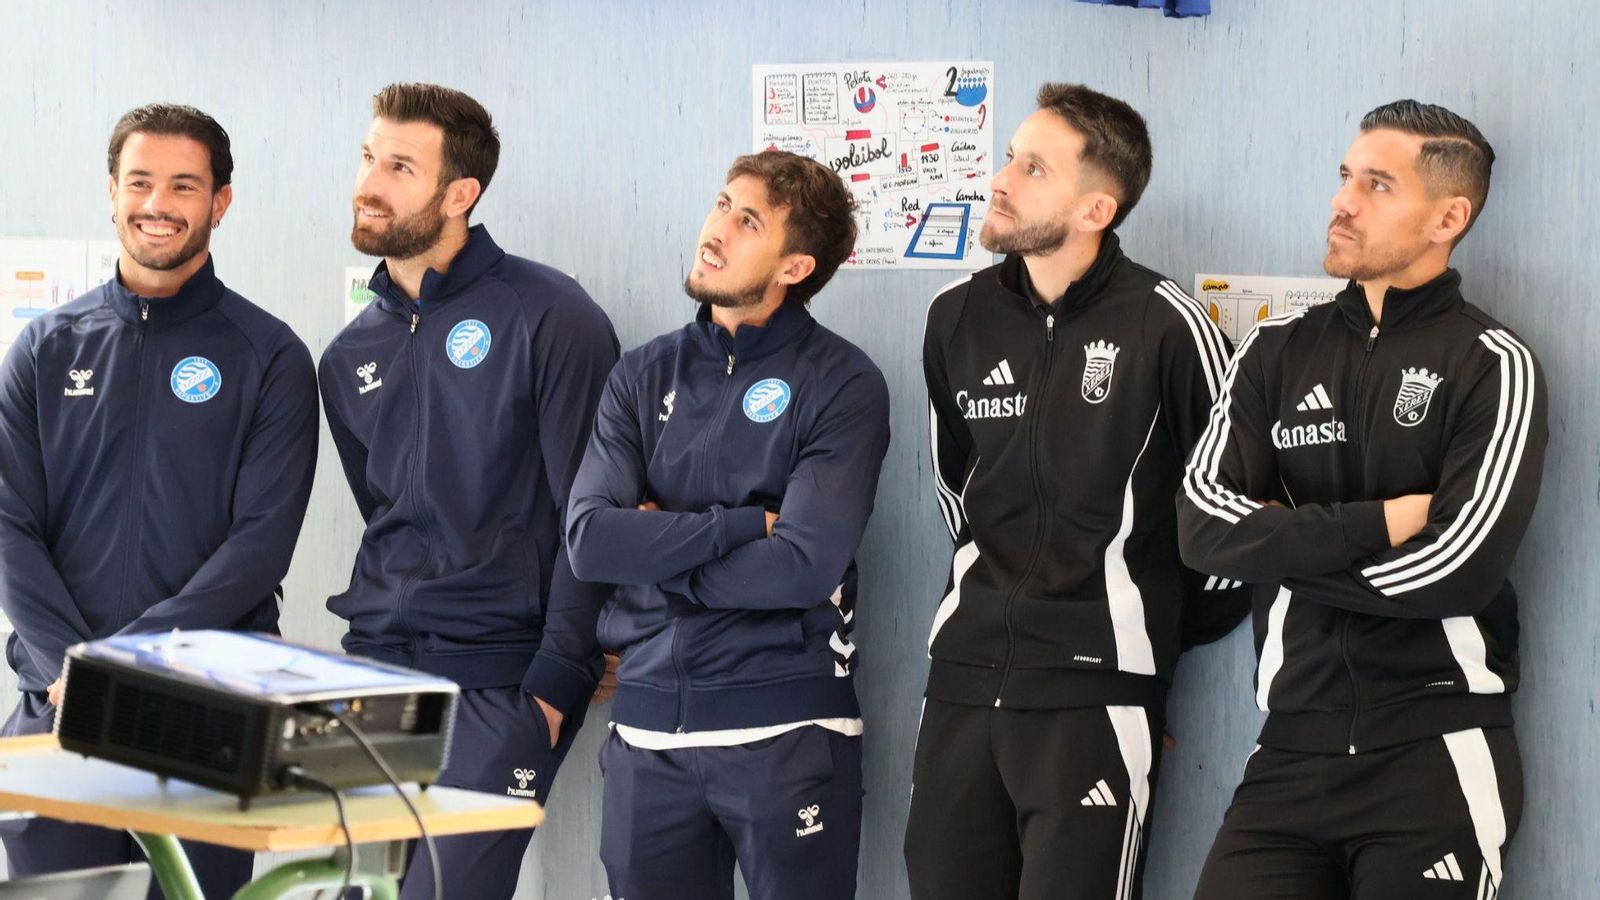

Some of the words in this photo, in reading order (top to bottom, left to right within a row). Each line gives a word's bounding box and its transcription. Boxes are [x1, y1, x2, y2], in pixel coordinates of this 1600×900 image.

[843, 70, 872, 91] Pelota
[943, 66, 958, 97] 2
[768, 88, 776, 99] 3
[768, 103, 782, 114] 25
[829, 137, 893, 173] voleibol
[956, 188, 986, 203] Cancha
[901, 197, 920, 212] Red
[1202, 283, 1229, 292] campo
[64, 386, 94, 397] hummel
[358, 377, 382, 395] hummel
[507, 786, 536, 798] hummel
[796, 821, 824, 838] hummel
